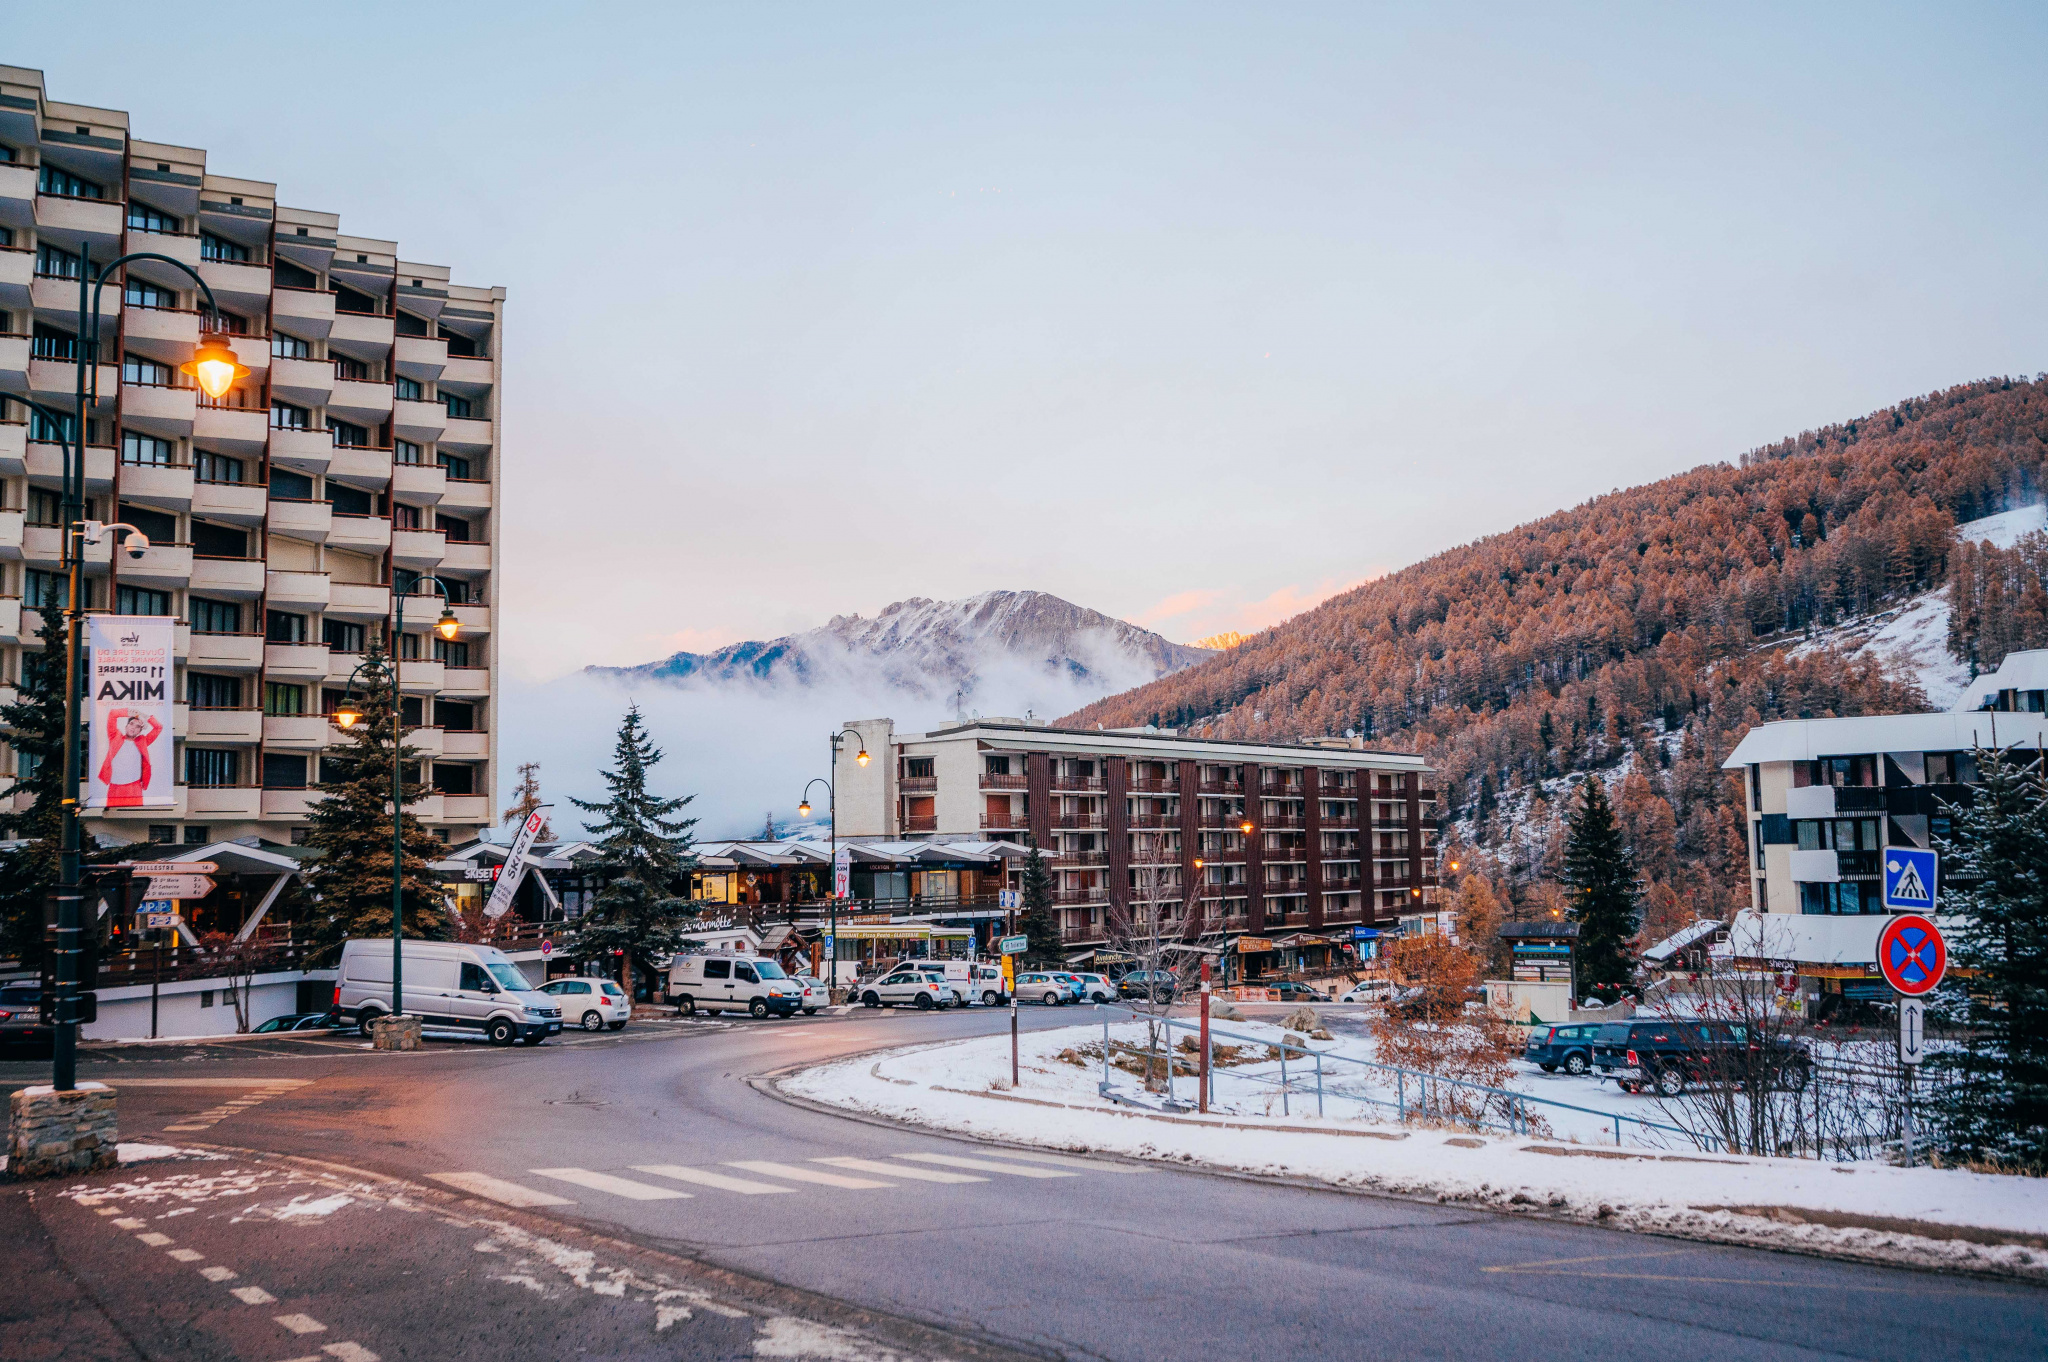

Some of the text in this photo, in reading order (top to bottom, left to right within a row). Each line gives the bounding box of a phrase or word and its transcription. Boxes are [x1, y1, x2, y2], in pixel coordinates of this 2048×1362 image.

[508, 829, 530, 880] SKISET
[464, 868, 494, 879] SKISET
[1095, 952, 1124, 963] Avalanche
[1768, 959, 1795, 970] sherpa
